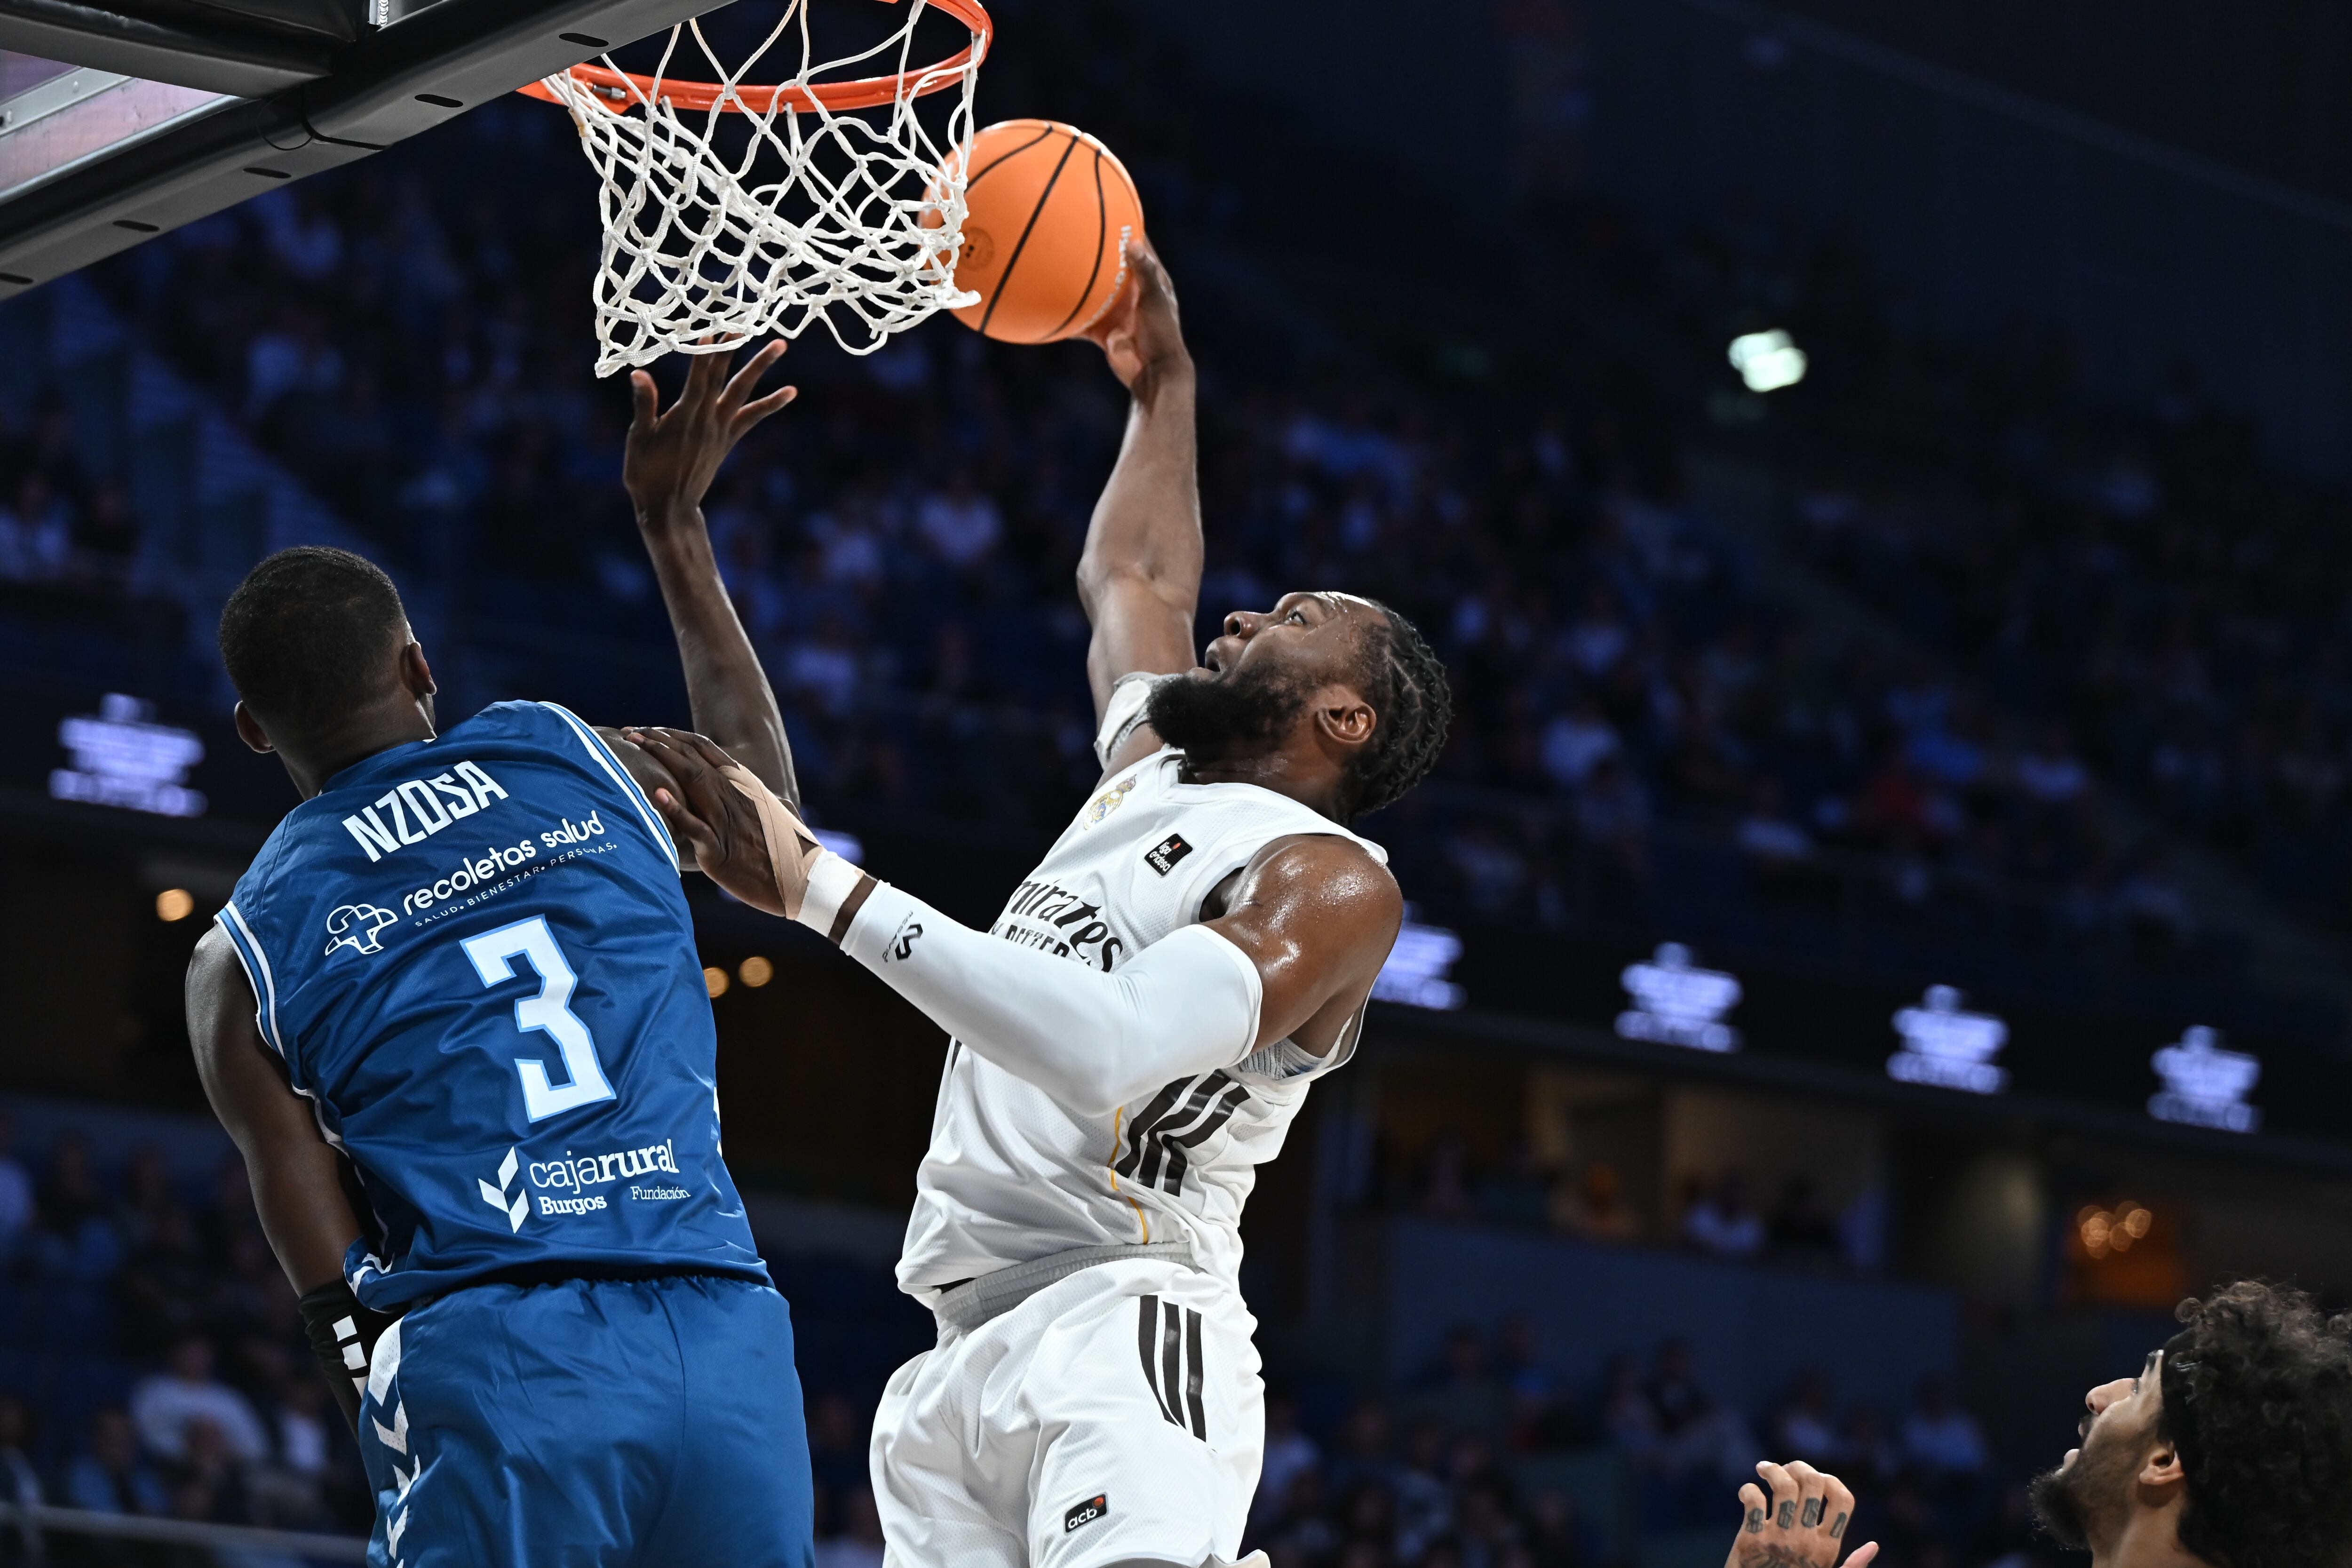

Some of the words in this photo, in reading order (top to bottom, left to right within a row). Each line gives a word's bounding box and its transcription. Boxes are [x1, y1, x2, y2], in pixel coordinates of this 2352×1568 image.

[342, 760, 509, 863] NZOSA
[403, 840, 536, 915] recoletas
[540, 810, 605, 848] salud
[1159, 842, 1172, 855] liga
[459, 914, 617, 1123] 3
[529, 1138, 680, 1194] cajarural
[538, 1195, 607, 1215] Burgos
[630, 1186, 691, 1200] Fundación
[1068, 1508, 1097, 1528] acb
